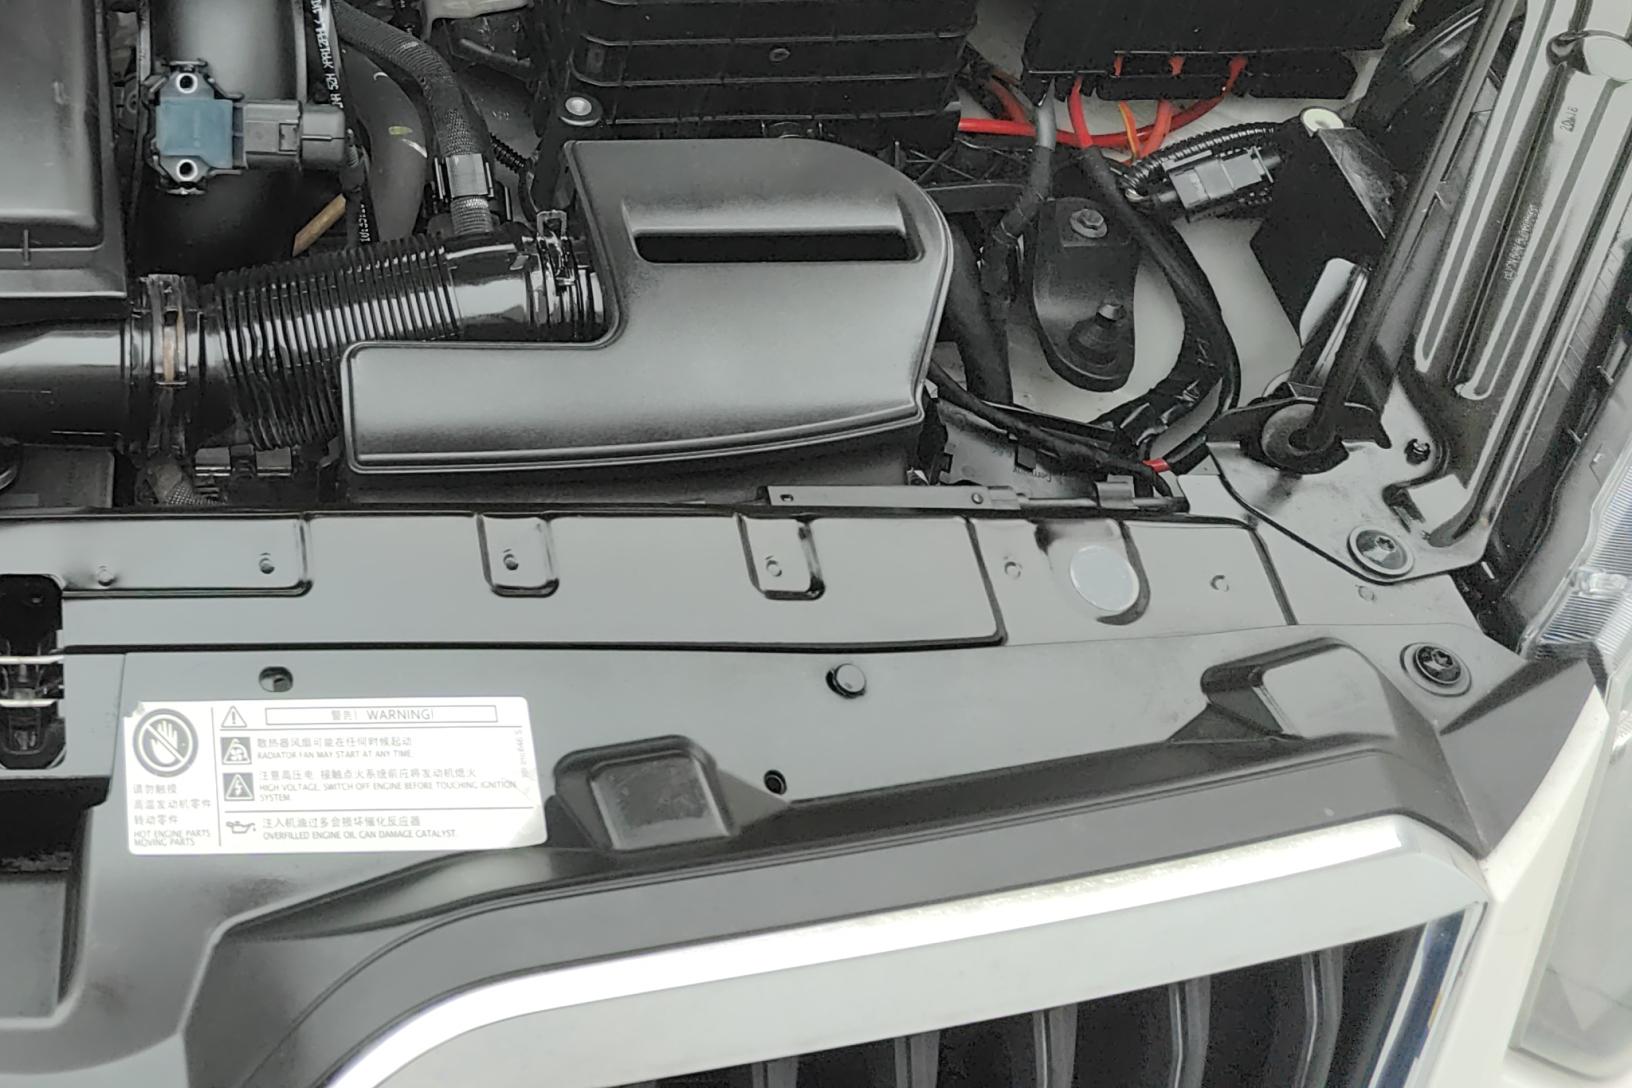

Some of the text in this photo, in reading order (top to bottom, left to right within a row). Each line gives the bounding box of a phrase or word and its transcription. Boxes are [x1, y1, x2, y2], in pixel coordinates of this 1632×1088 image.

[366, 708, 435, 721] WARNING!
[257, 750, 297, 760] RADIATOR
[298, 750, 315, 759] FAN
[316, 750, 333, 759] MAY
[335, 749, 360, 759] START
[362, 749, 373, 758] AT
[374, 749, 391, 758] ANY
[259, 782, 280, 792] HIGH
[323, 782, 354, 791] SWITCH
[355, 781, 371, 791] OFF
[372, 781, 403, 791] ENGINE
[403, 780, 433, 790] BEFORE
[435, 780, 478, 790] TOUCHING
[133, 829, 211, 839] HOT ENGINE PARTS
[262, 830, 311, 841] OVERFILLED
[311, 830, 342, 840] ENGINE
[342, 830, 357, 840] OIL
[358, 829, 377, 839] CAN
[378, 829, 414, 839] DAMAGE
[133, 837, 196, 847] MOVING PARTS
